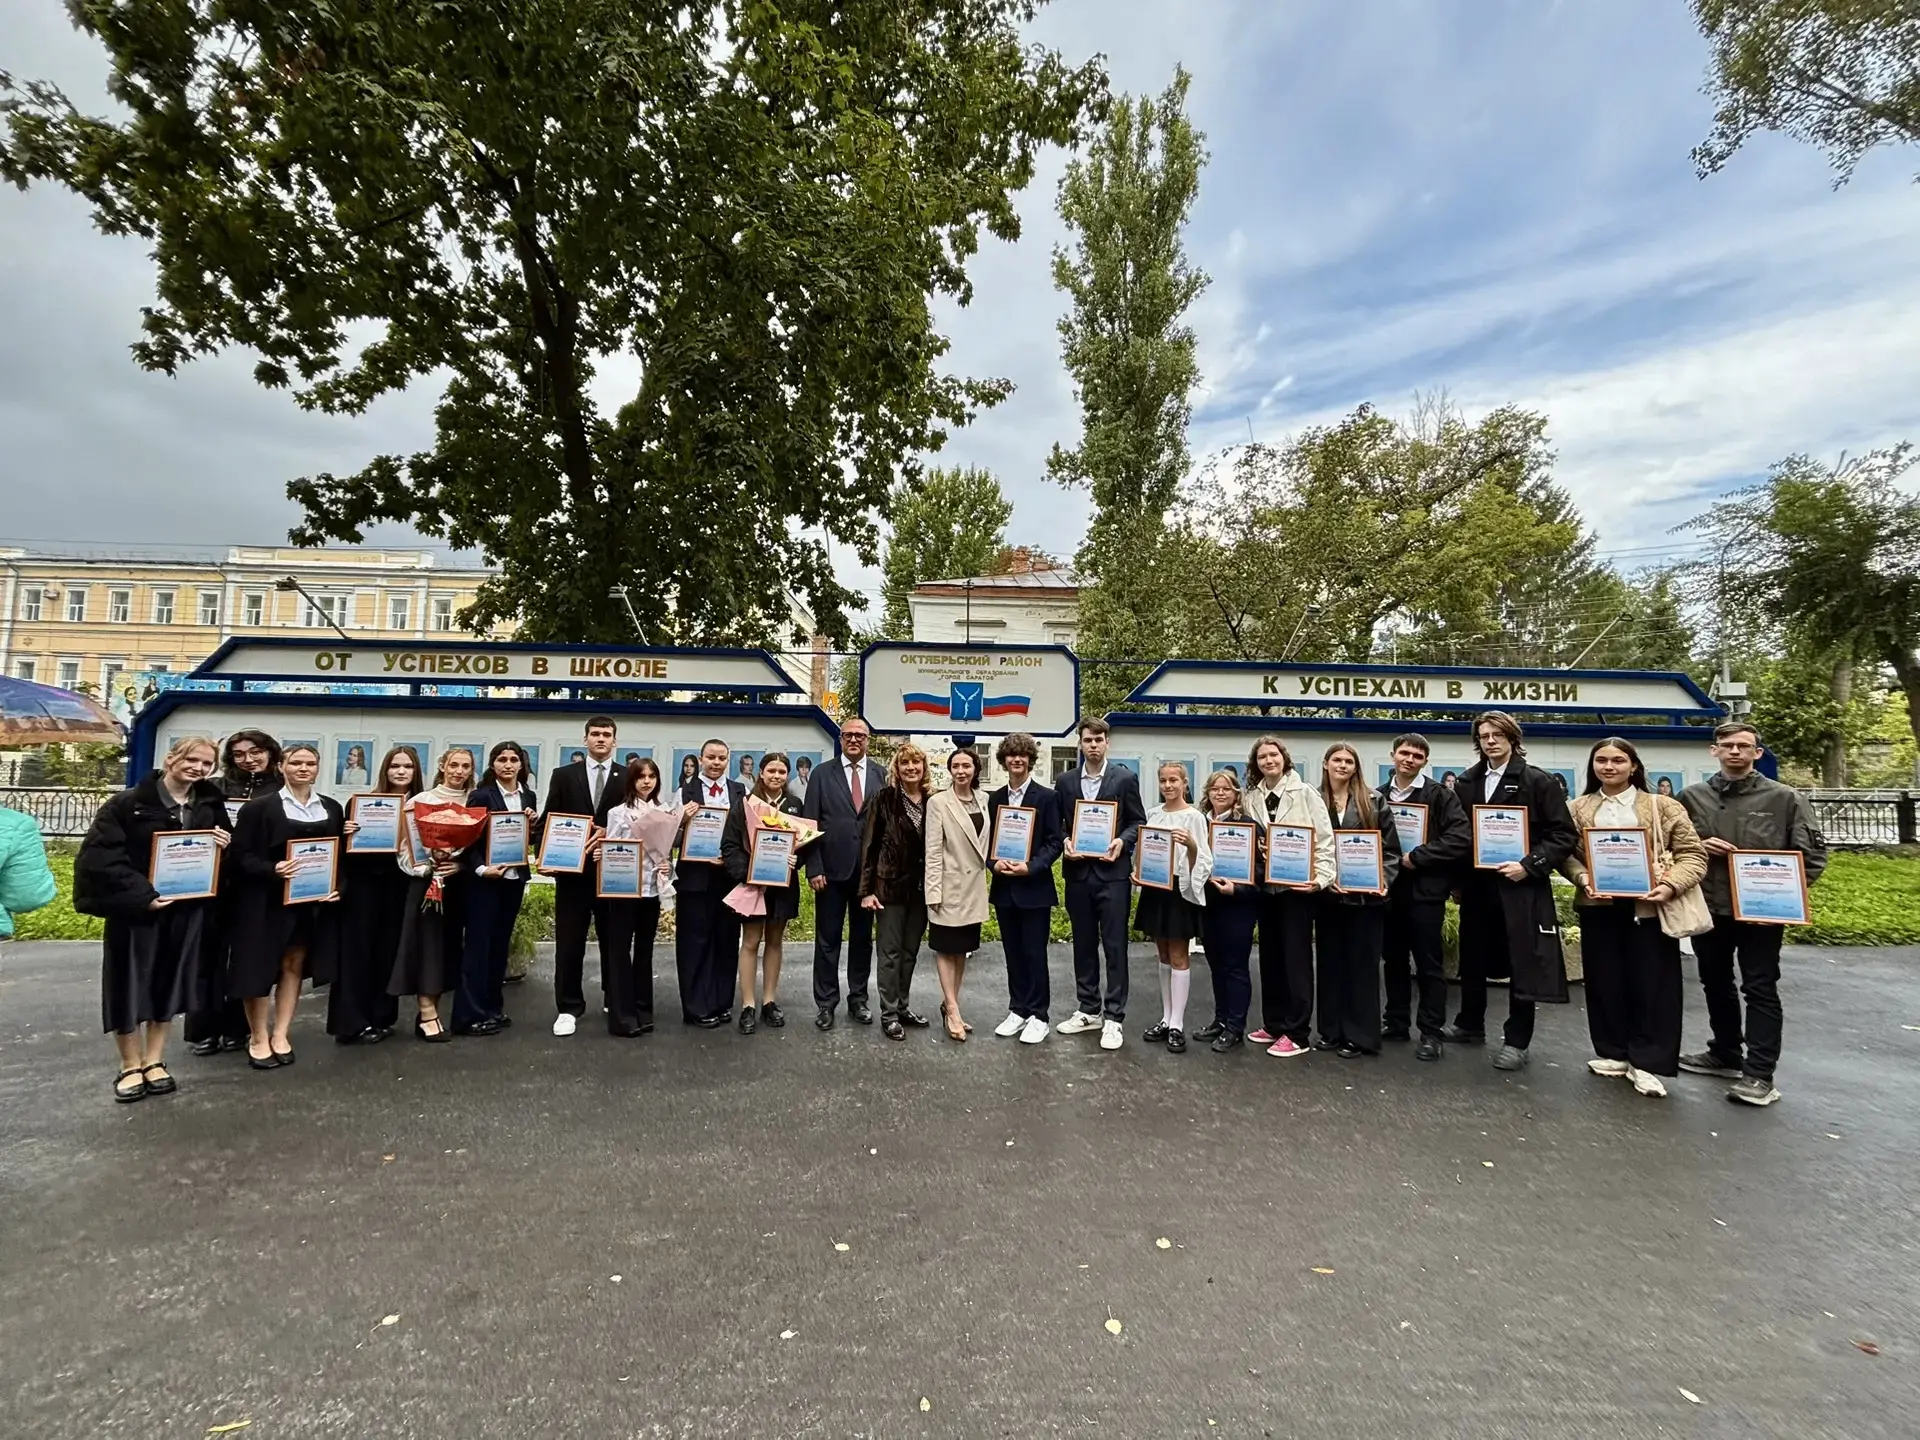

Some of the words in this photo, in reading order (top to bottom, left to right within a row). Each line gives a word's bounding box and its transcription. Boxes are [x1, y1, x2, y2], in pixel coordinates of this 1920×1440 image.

[315, 652, 352, 671] ОТ
[383, 653, 510, 675] УСПЕХОВ
[531, 657, 549, 675] В
[569, 658, 668, 679] ШКОЛЕ
[900, 654, 990, 666] ОКТЯБРЬСКИЙ
[999, 655, 1043, 667] РАЙОН
[1263, 675, 1278, 694] К
[1299, 676, 1426, 699] УСПЕХАМ
[1447, 681, 1462, 699] В
[1483, 682, 1579, 702] ЖИЗНИ
